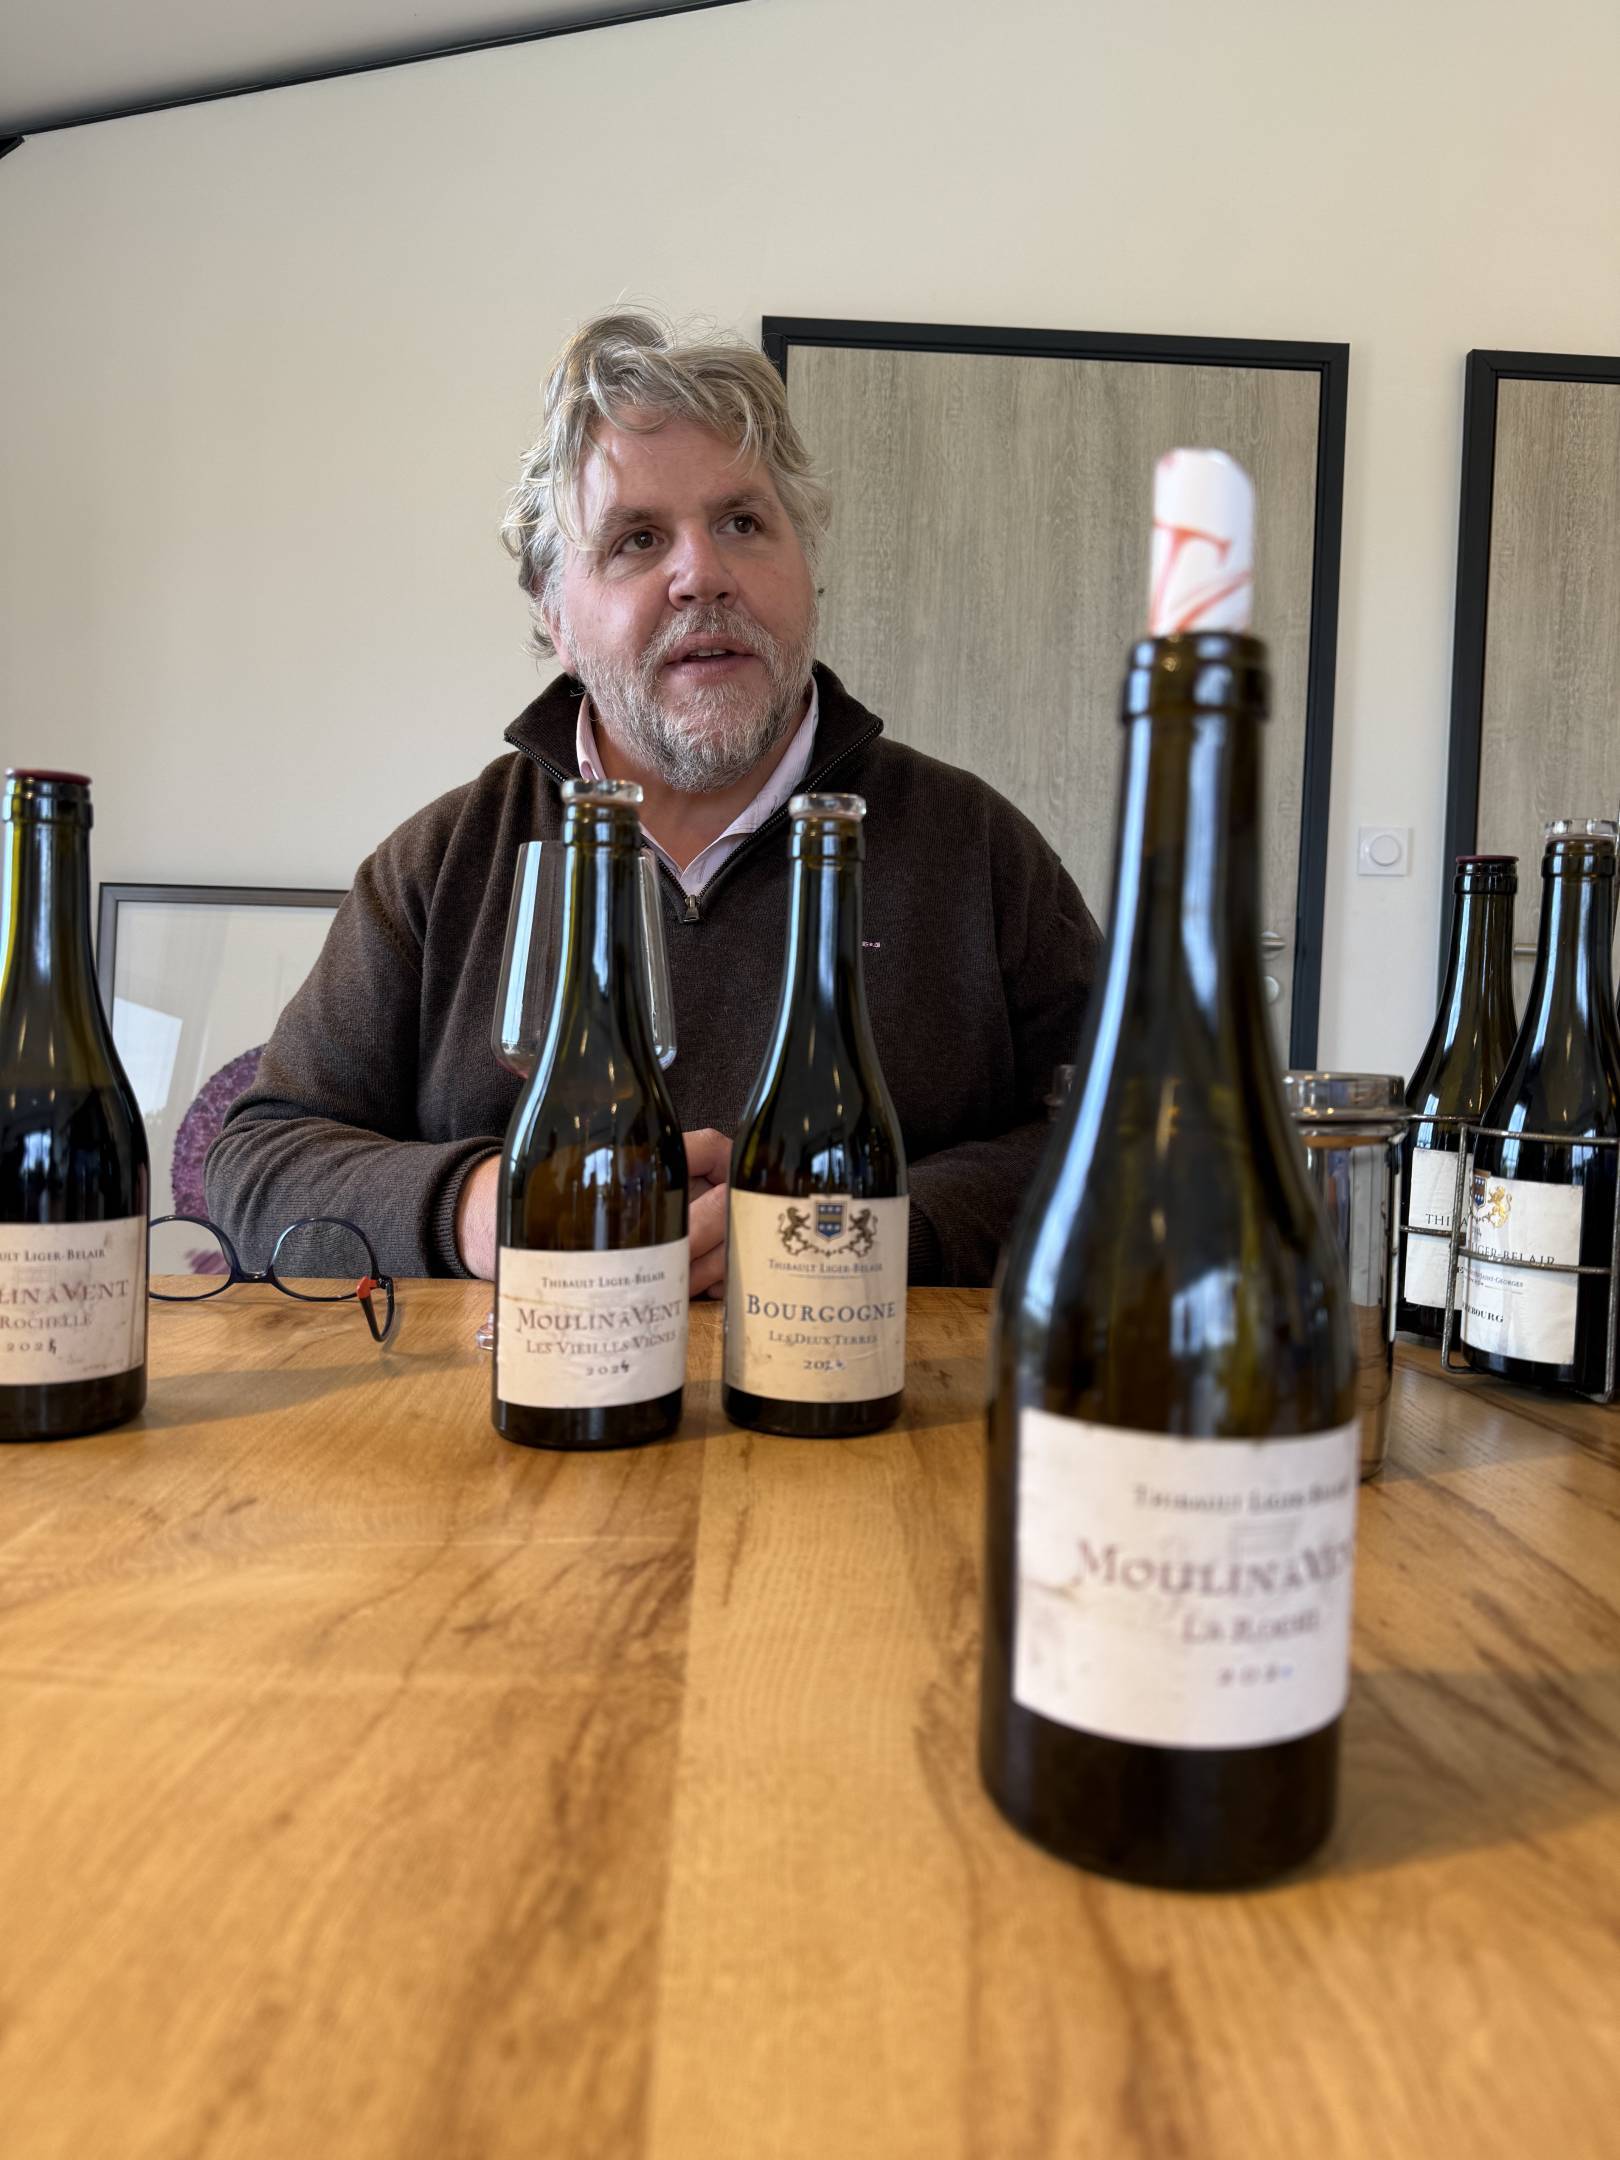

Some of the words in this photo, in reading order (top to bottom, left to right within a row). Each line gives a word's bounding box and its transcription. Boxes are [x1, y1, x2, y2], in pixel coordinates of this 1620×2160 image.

[1425, 1213, 1469, 1226] THIA
[24, 1248, 105, 1262] LIGER-BELAIR
[61, 1279, 129, 1301] VENT
[541, 1276, 594, 1289] THIBAULT
[599, 1270, 665, 1288] LIGER-BELAIR
[516, 1307, 615, 1334] MOULIN
[631, 1299, 684, 1324] VENT
[746, 1294, 896, 1323] BOURGOGNE
[526, 1338, 553, 1355] LES
[556, 1341, 629, 1356] VIEILLES
[630, 1330, 677, 1350] VIGNES
[1070, 1538, 1276, 1597] MOULIN
